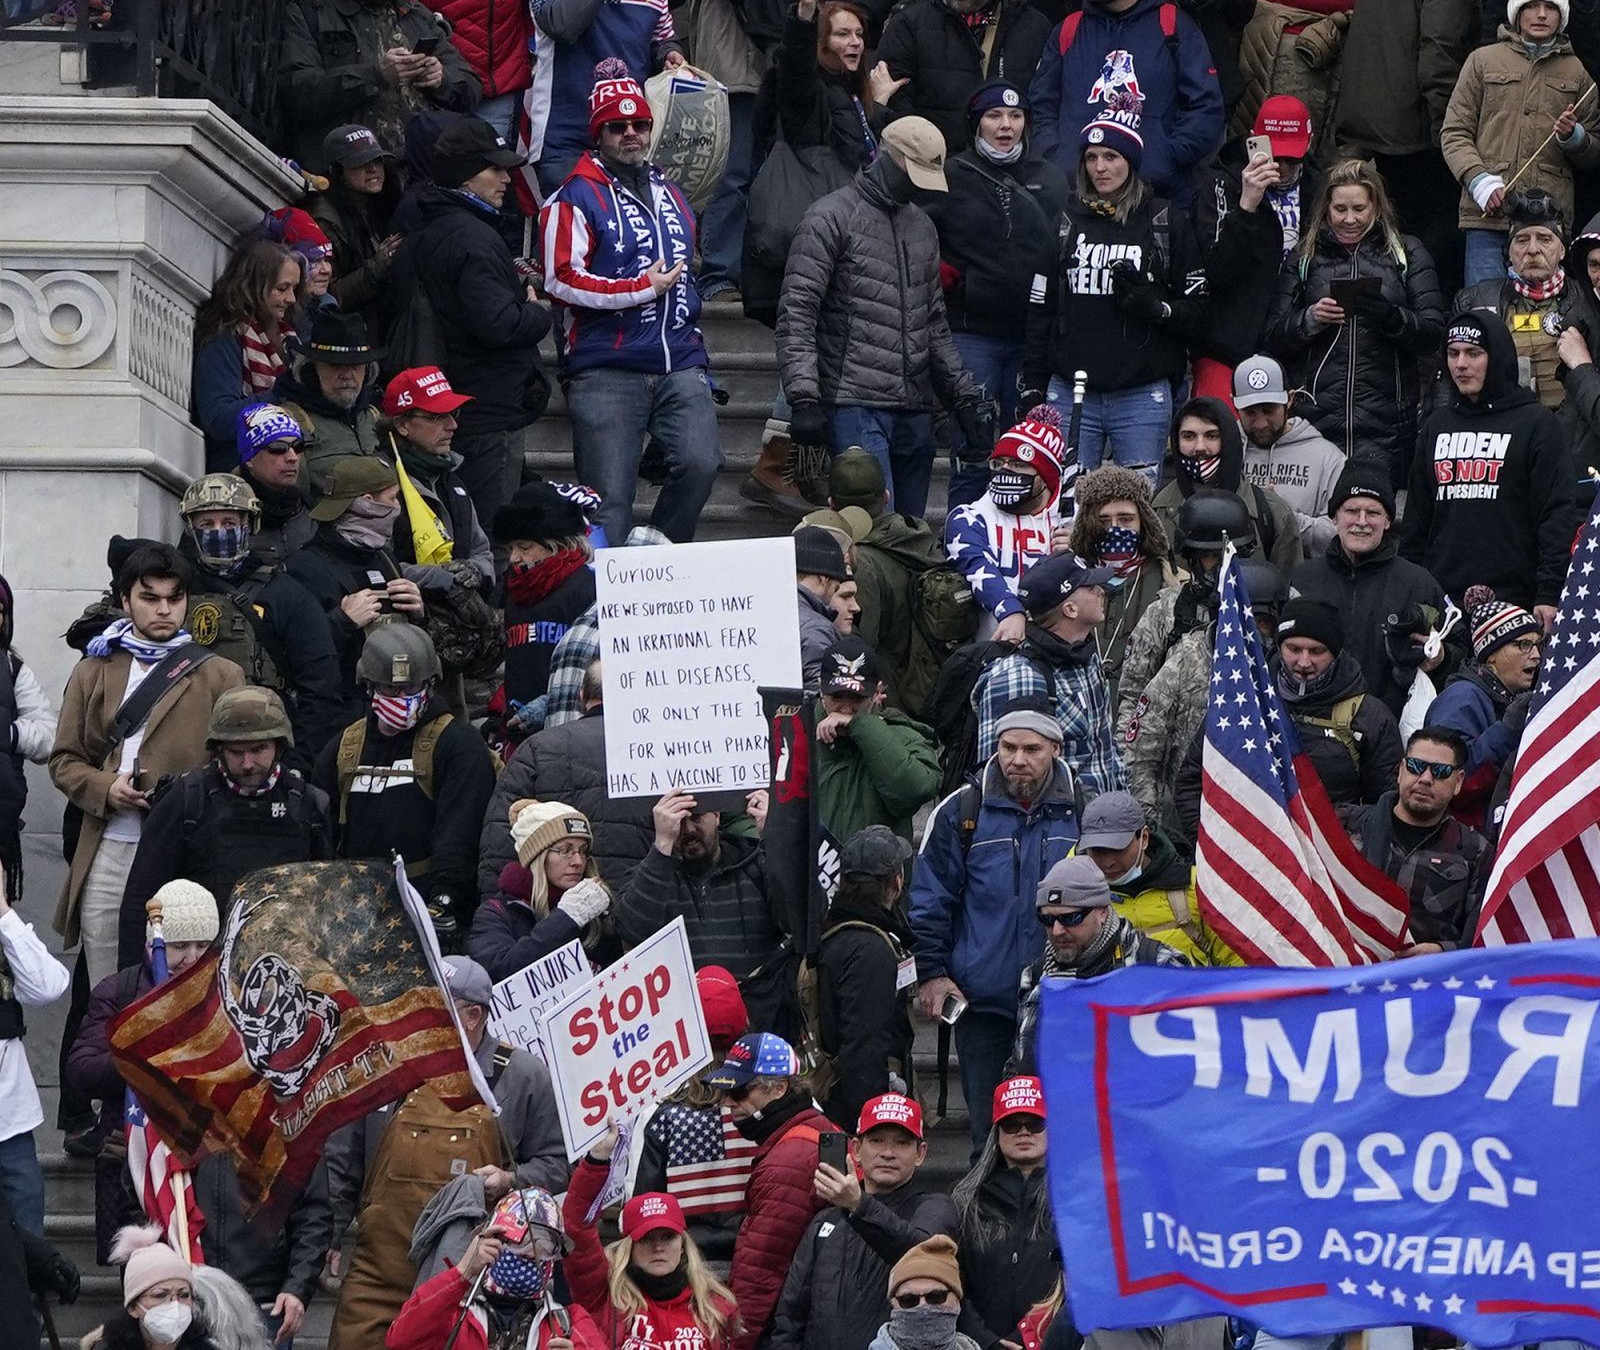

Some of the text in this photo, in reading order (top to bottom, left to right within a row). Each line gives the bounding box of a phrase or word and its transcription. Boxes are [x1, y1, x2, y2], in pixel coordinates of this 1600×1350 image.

[622, 101, 634, 113] 45
[1090, 131, 1101, 141] 45
[621, 193, 655, 257] GREAT
[659, 195, 687, 237] AKE
[1450, 326, 1481, 339] TRUMP
[397, 391, 413, 408] 45
[1020, 447, 1032, 459] 45
[1436, 432, 1512, 460] BIDEN
[1000, 472, 1022, 485] LIVES
[1276, 463, 1311, 478] RIFLE
[1455, 460, 1504, 483] NOT
[1446, 484, 1498, 502] PRESIDENT
[600, 594, 754, 620] ARE WE SUPPOSED TO HAVE
[536, 620, 568, 643] STEA
[1497, 614, 1535, 639] GREAT
[611, 626, 758, 654] AN IRRATIONAL FEAR
[619, 671, 641, 690] OF
[646, 667, 671, 687] ALL
[631, 700, 748, 725] OR ONLY THE
[629, 741, 655, 760] FOR
[660, 737, 714, 758] WHICH
[608, 760, 770, 794] HAS A VACCINE TO SE
[525, 943, 584, 997] INJURY
[568, 964, 672, 1057] Stop
[610, 1018, 652, 1060] the
[579, 1021, 695, 1128] Steal
[1008, 1078, 1033, 1090] KEEP
[882, 1094, 907, 1105] KEEP
[1001, 1088, 1042, 1103] AMERICA
[1005, 1098, 1037, 1110] GREAT
[871, 1103, 914, 1117] AMERICA
[876, 1110, 909, 1122] GREAT
